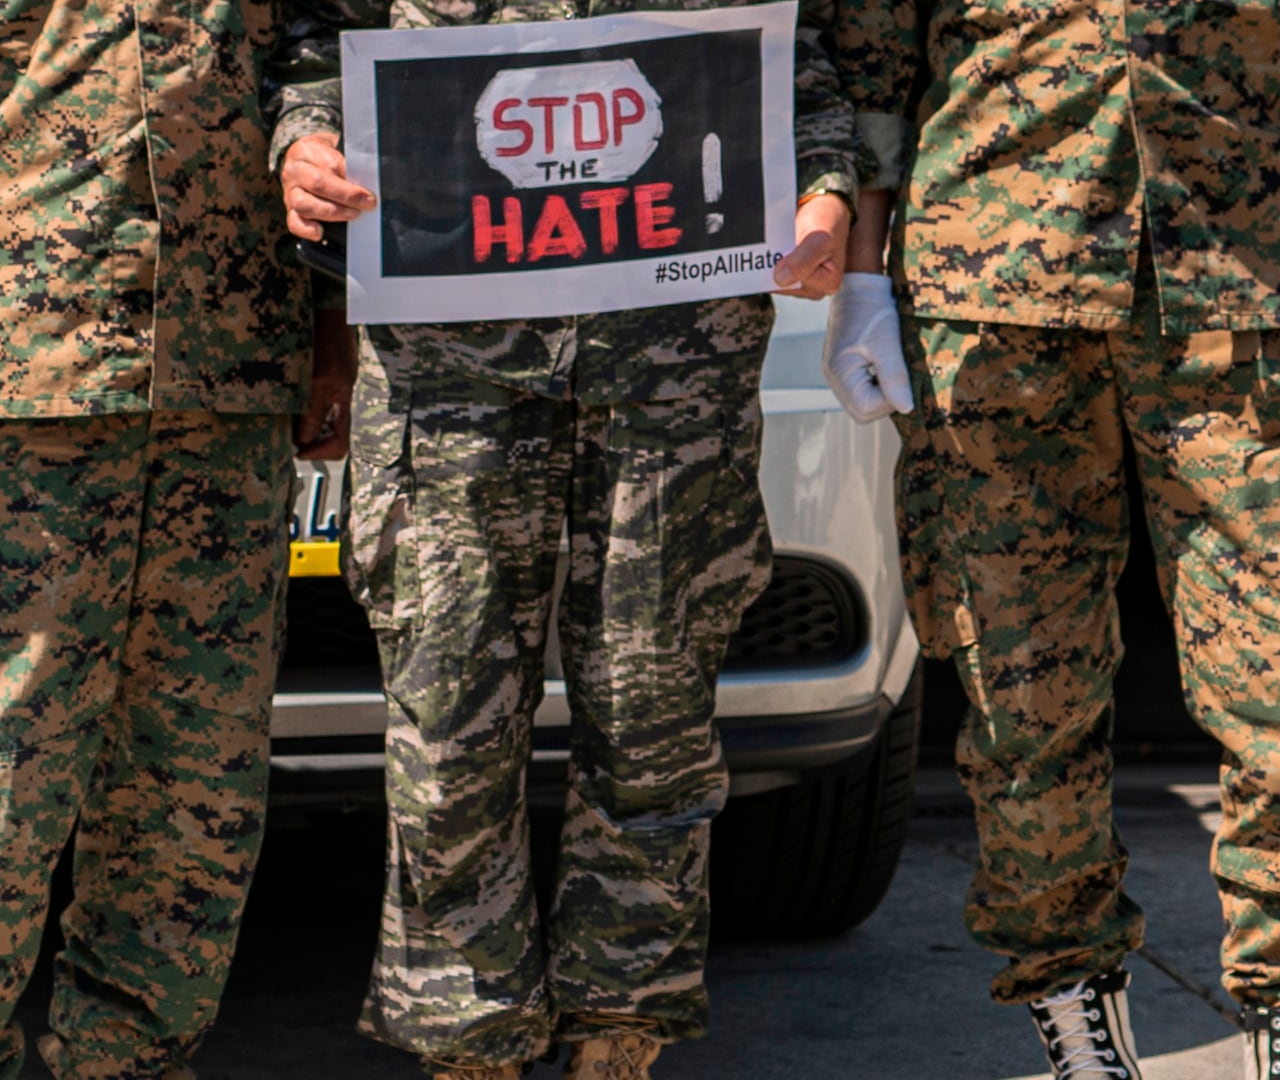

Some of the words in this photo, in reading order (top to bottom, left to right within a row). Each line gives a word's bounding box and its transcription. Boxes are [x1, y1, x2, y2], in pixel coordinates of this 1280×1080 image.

[493, 87, 646, 157] STOP
[535, 158, 599, 182] THE
[471, 181, 684, 264] HATE
[655, 251, 784, 285] #StopAllHate
